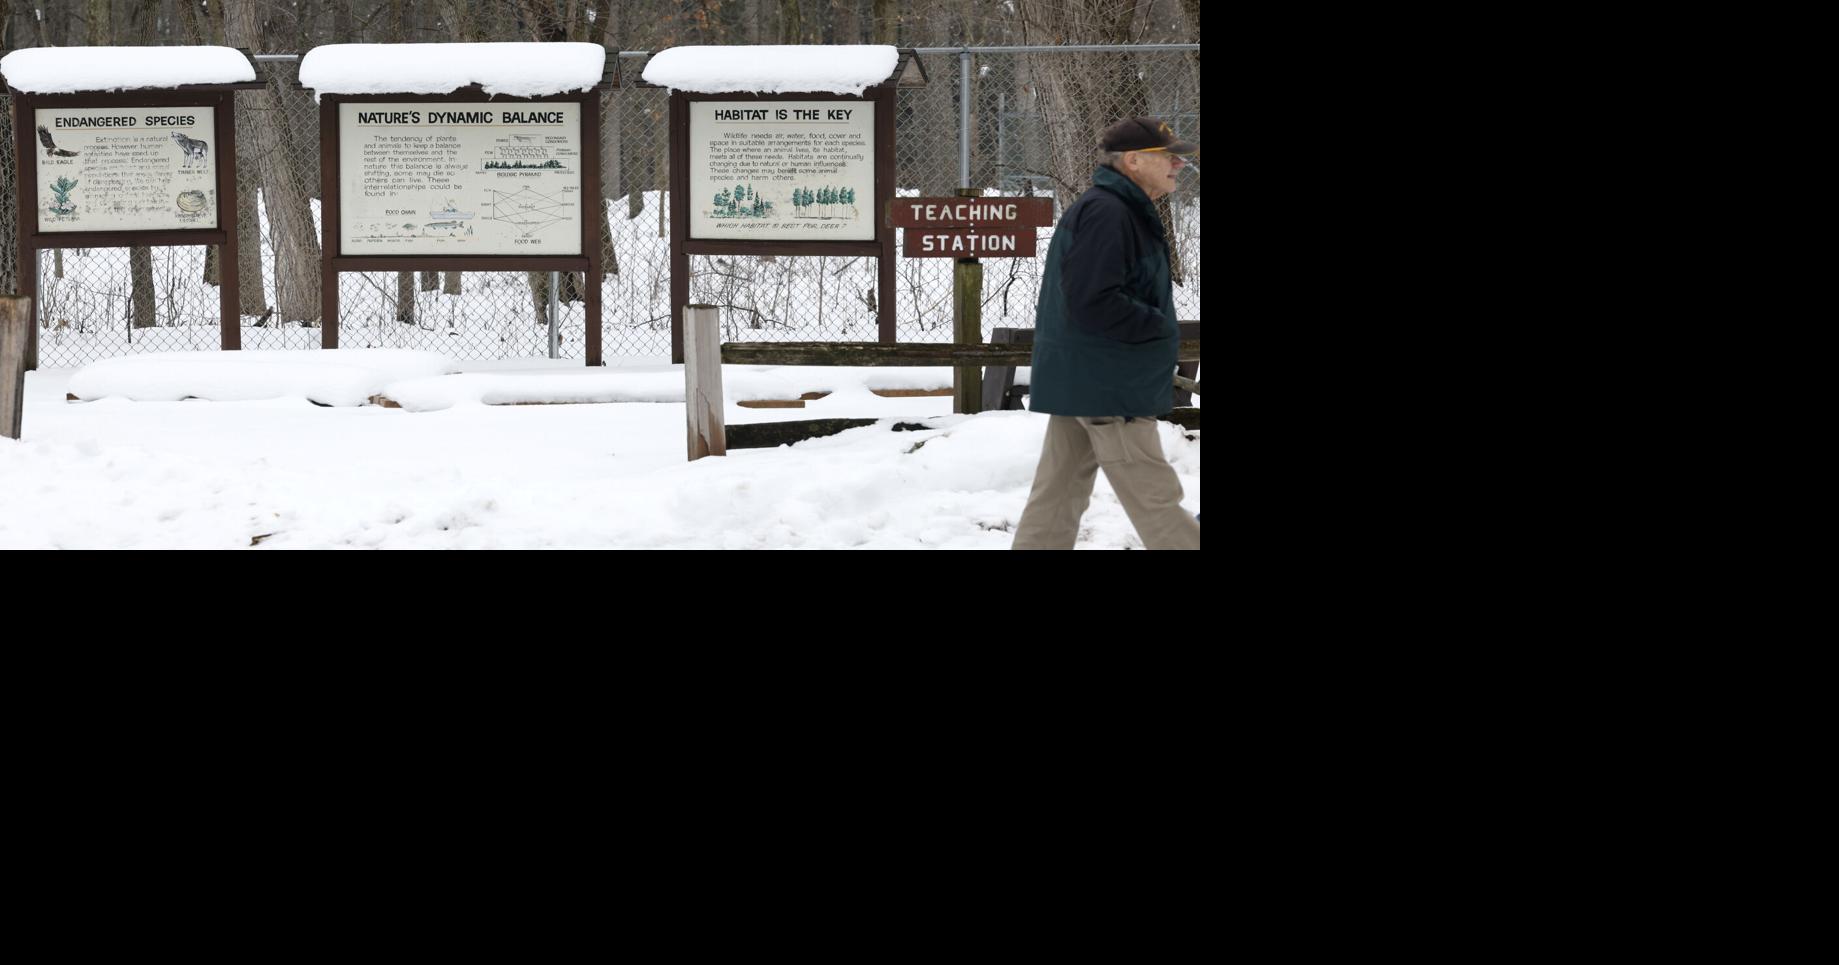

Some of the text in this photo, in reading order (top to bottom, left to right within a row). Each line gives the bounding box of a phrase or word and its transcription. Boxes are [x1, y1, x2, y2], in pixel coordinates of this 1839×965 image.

[56, 116, 195, 128] ENDANGERED SPECIES
[358, 110, 564, 124] NATURE'S DYNAMIC BALANCE
[715, 110, 852, 120] HABITAT IS THE KEY
[911, 204, 1017, 221] TEACHING
[922, 235, 1015, 251] STATION
